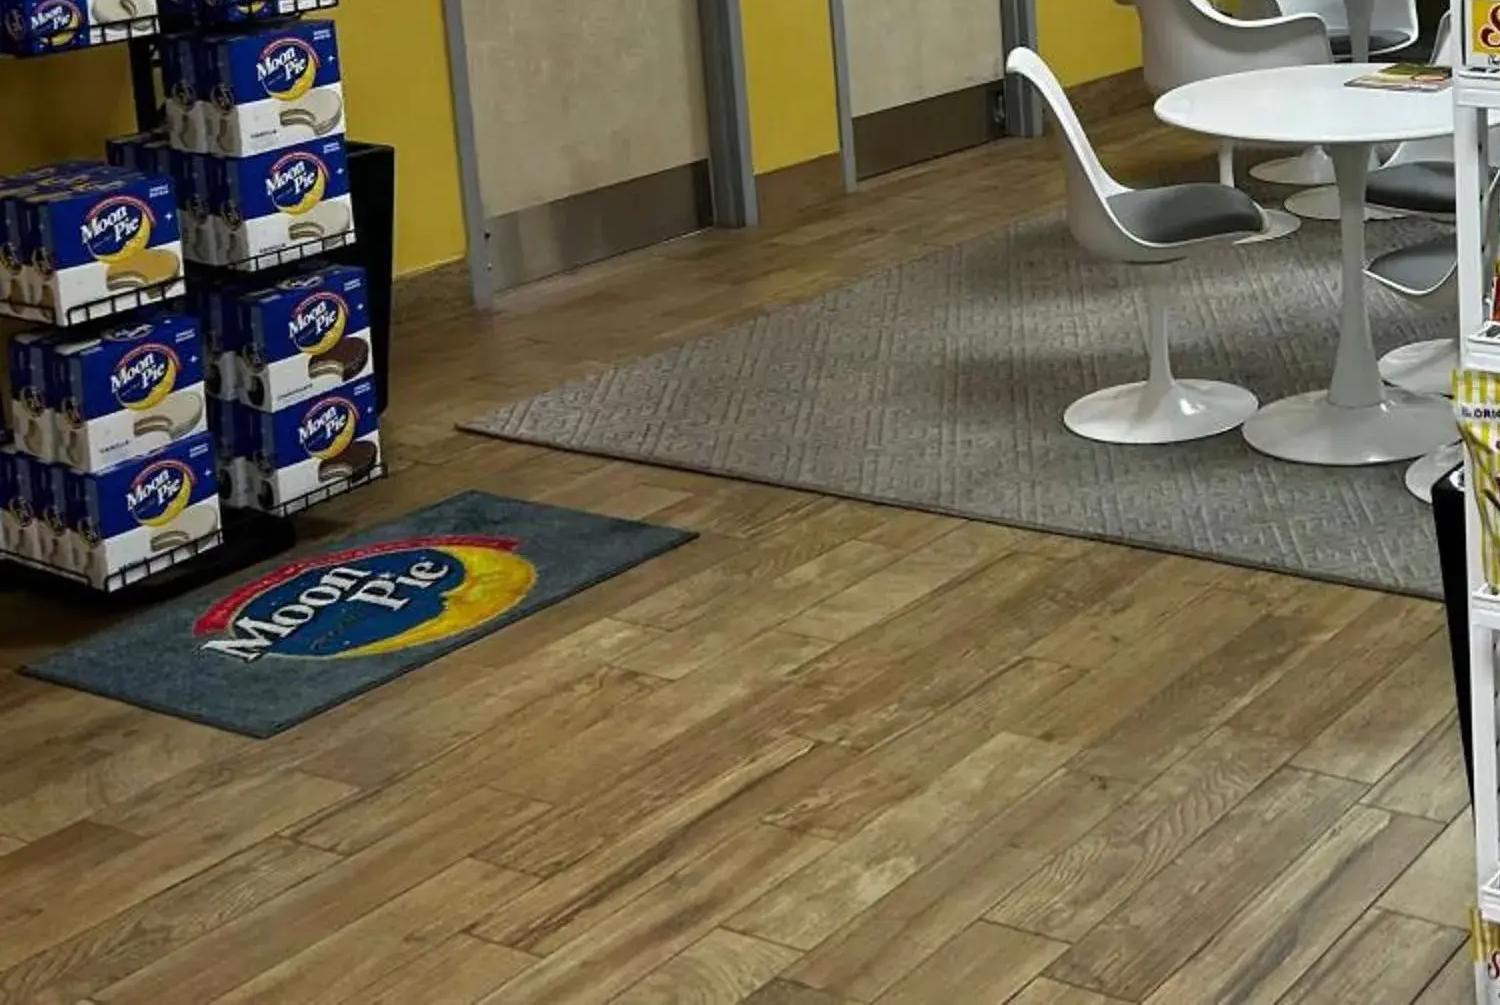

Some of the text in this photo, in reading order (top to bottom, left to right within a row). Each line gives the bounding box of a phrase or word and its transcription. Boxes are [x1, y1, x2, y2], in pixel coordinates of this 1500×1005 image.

[257, 47, 295, 81] Moon
[284, 57, 307, 81] Pie
[265, 161, 305, 195] Moon
[294, 170, 315, 195] Pie
[80, 206, 128, 244] Moon
[114, 216, 139, 243] Pie
[288, 301, 326, 340] Moon
[316, 310, 337, 333] Pie
[110, 352, 154, 394] Moon
[142, 362, 165, 389] Pie
[298, 406, 336, 443] Moon
[325, 415, 346, 438] Pie
[126, 469, 170, 510] Moon
[158, 478, 181, 505] Pie
[347, 556, 449, 612] Pie
[201, 566, 374, 663] Moon
